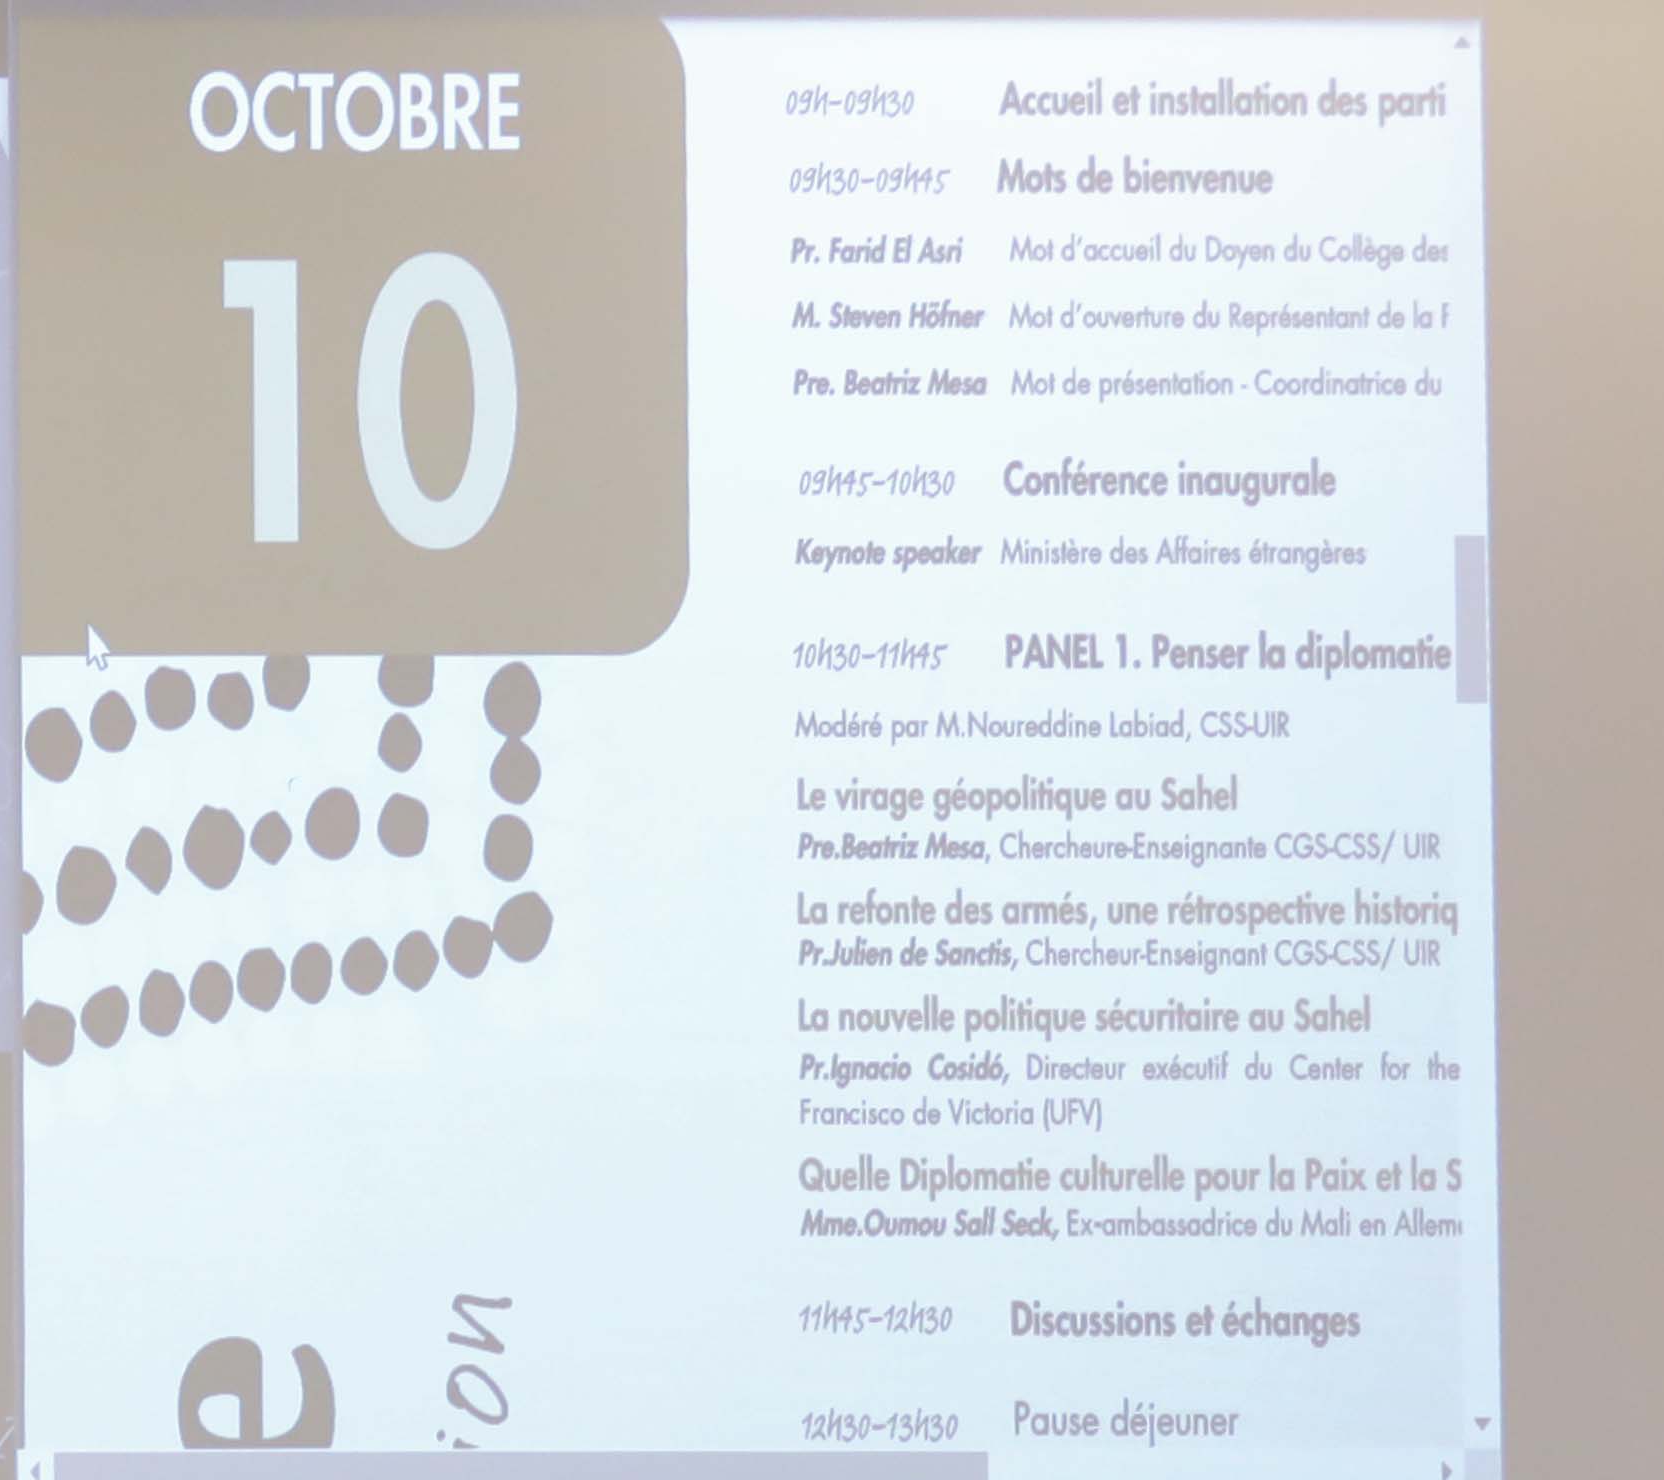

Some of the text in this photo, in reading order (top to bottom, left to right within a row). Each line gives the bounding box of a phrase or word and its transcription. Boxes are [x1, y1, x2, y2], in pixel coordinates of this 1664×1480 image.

[190, 71, 520, 152] OCTOBRE
[999, 77, 1446, 128] Accueil et installation des parti
[997, 155, 1273, 194] Mots de bienvenue
[791, 234, 963, 264] Pr. Farid El Asri
[792, 299, 985, 329] M. Steven Höfner
[224, 252, 517, 549] 10
[794, 368, 987, 396] Pre. Beatriz Mesa
[1004, 456, 1336, 507] Conférence inaugurale
[795, 535, 982, 572] Keynote speaker
[1000, 535, 1366, 573] Ministère des Affaires étrangères
[1006, 630, 1450, 680] PANEL 1. Penser la diplomatie
[795, 708, 1290, 746] Modéré par M.Noureddine Labiad, CSS-UIR
[797, 774, 1237, 821] Le virage géopolitique au Sahel
[797, 888, 1458, 936] La refonte des armés, une rétrospective historiq
[798, 994, 1371, 1042] La nouvelle politique sécuritaire au Sahel
[799, 1154, 1437, 1202] Quelle Diplomatie culturelle pour la Paix et la
[1011, 1296, 1360, 1348] Discussions et échanges
[1014, 1397, 1239, 1447] Pause déjeuner
